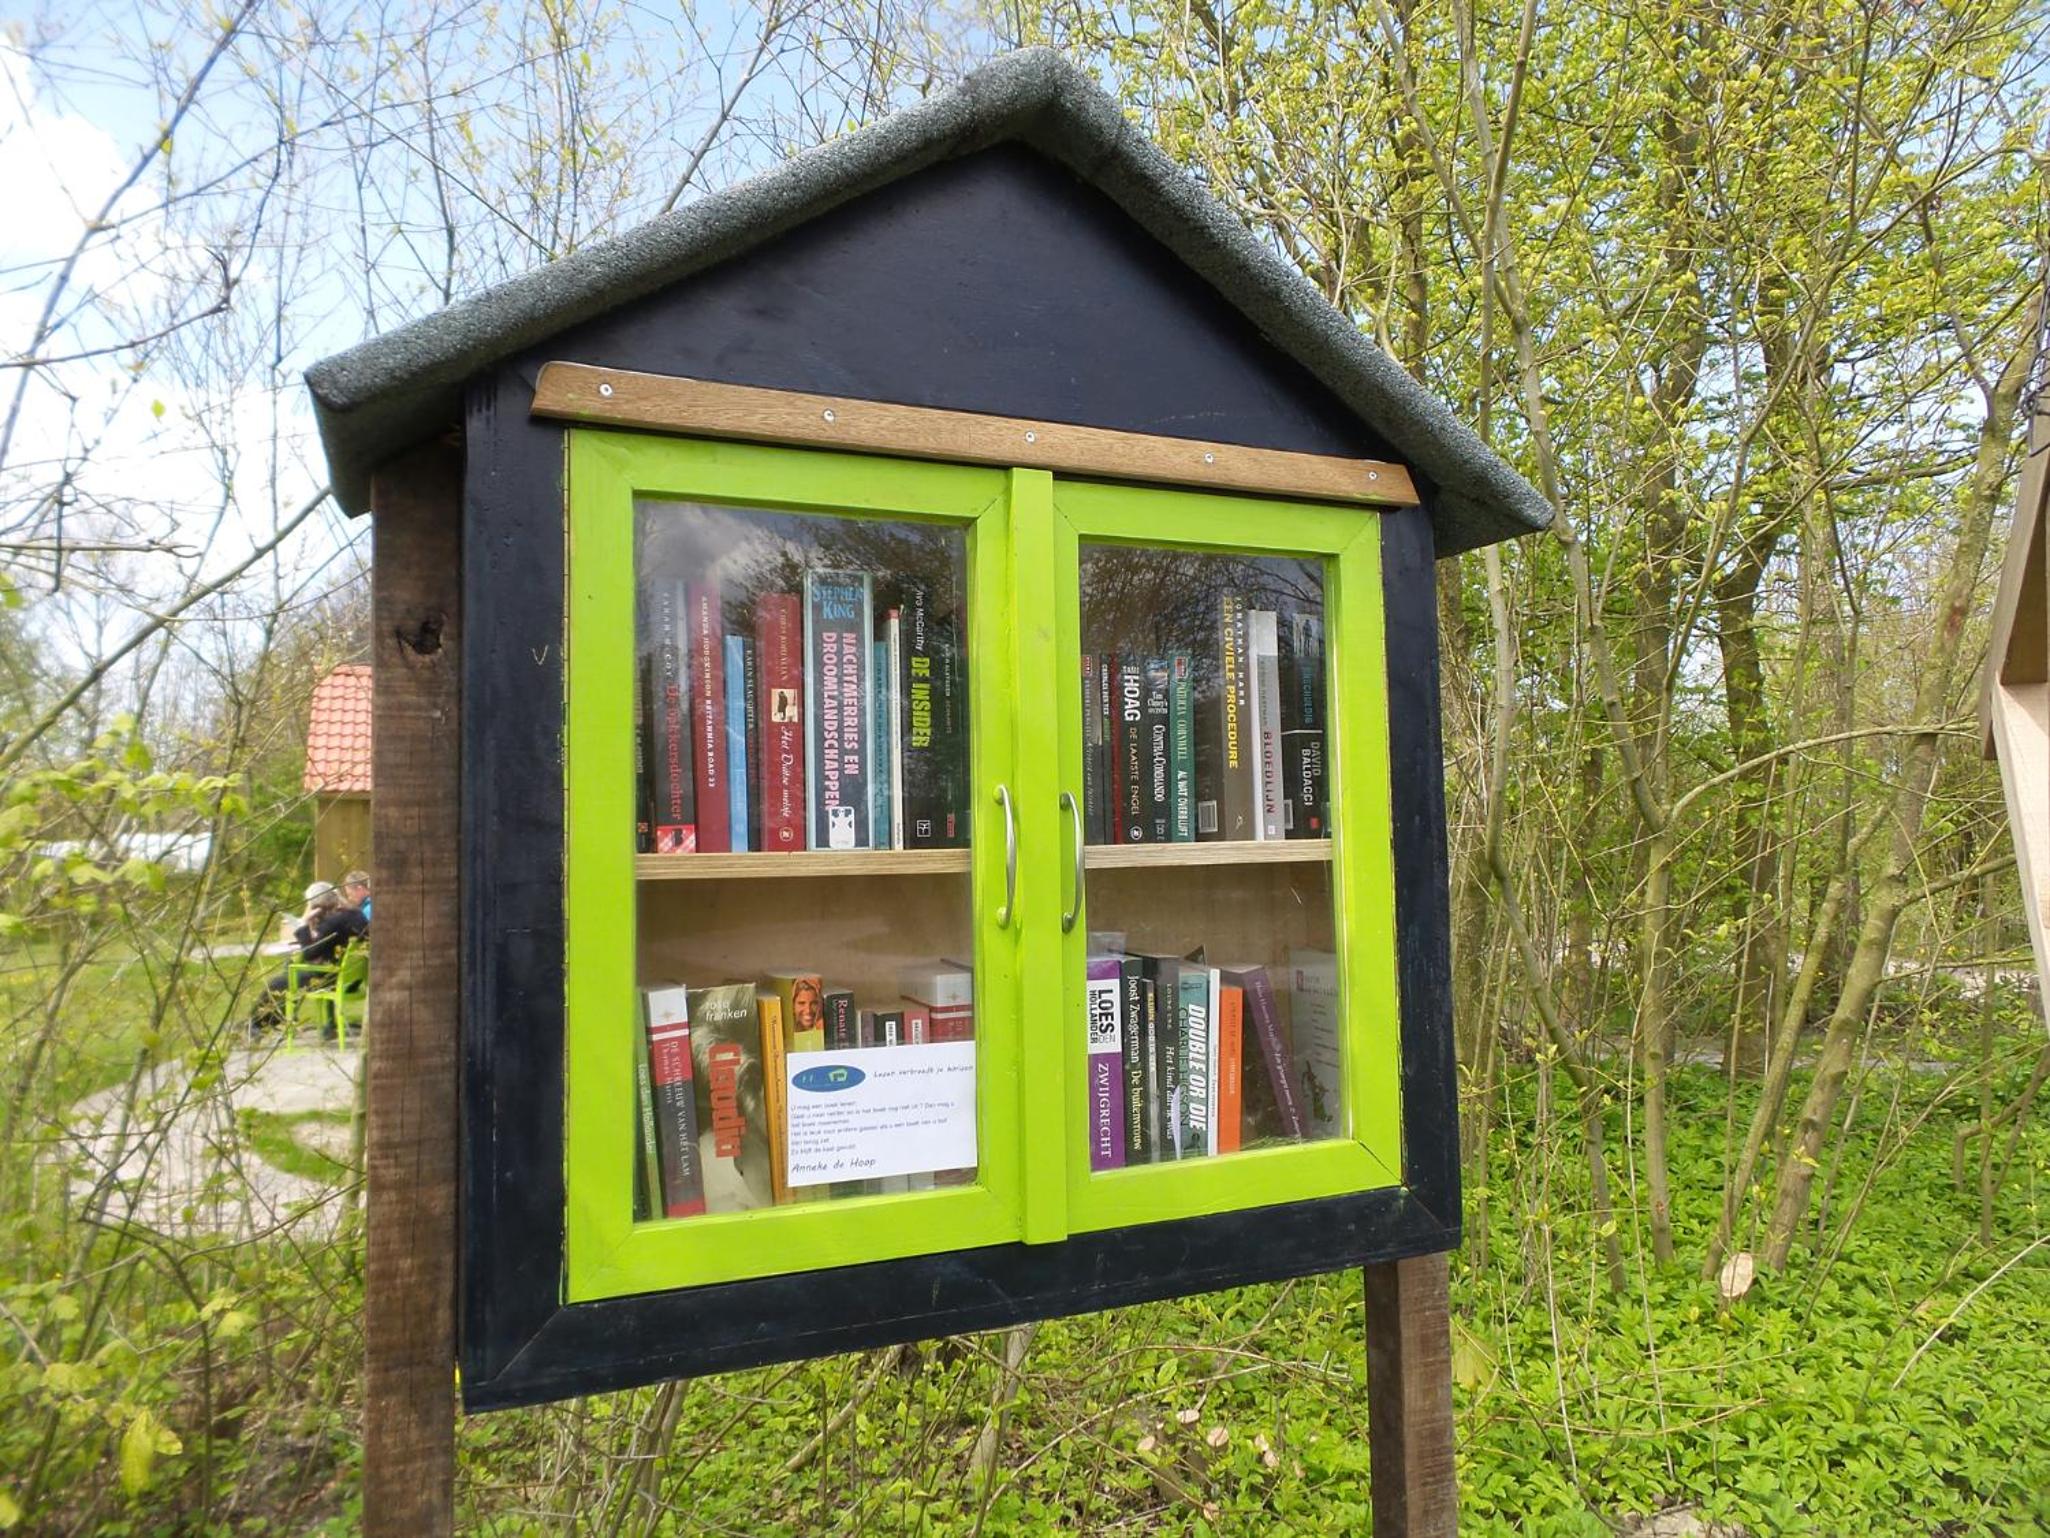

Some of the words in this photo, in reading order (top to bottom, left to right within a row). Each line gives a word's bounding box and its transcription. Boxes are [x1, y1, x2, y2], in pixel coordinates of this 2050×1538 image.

[812, 587, 865, 602] STEPHEN
[822, 601, 856, 620] KING
[1222, 596, 1235, 624] EEN
[914, 608, 926, 652] McCarthy
[911, 656, 931, 678] DE
[1223, 628, 1236, 681] CIVIELE
[842, 632, 859, 750] NACHTMERRIES
[1123, 674, 1142, 722] HOAG
[911, 682, 932, 748] INSIDER
[1226, 684, 1239, 770] PROCEDURE
[780, 726, 793, 750] Het
[1128, 726, 1139, 741] DE
[707, 752, 715, 775] ROAD
[843, 754, 860, 775] EN
[1129, 743, 1140, 782] LAATSTE
[1263, 730, 1277, 814] BLOEDLIJN
[1310, 741, 1322, 776] DAVID
[1177, 781, 1190, 797] WAT
[1301, 748, 1314, 806] BALDACCI
[1130, 785, 1142, 816] ENGEL
[1126, 975, 1142, 1002] Joost
[704, 1008, 748, 1022] franken
[1088, 989, 1100, 1045] HOLLANDER
[1097, 988, 1116, 1035] LOES
[1097, 1034, 1117, 1044] DEN
[1128, 1003, 1141, 1064] Zwagerman
[1178, 1007, 1190, 1069] CHARLIE
[1188, 1003, 1208, 1074] DOUBLE
[1165, 1046, 1176, 1063] Het
[1130, 1070, 1143, 1086] De
[1166, 1065, 1177, 1089] kind
[1188, 1074, 1207, 1099] OR
[641, 1086, 652, 1106] den
[1097, 1062, 1113, 1158] ZWIJGRECHT
[676, 1110, 688, 1131] VAN
[1131, 1087, 1144, 1151] buitenvrouw
[1188, 1102, 1207, 1132] DIE
[791, 1163, 828, 1174] Anneke
[833, 1160, 845, 1169] de
[850, 1156, 877, 1169] Hoop
